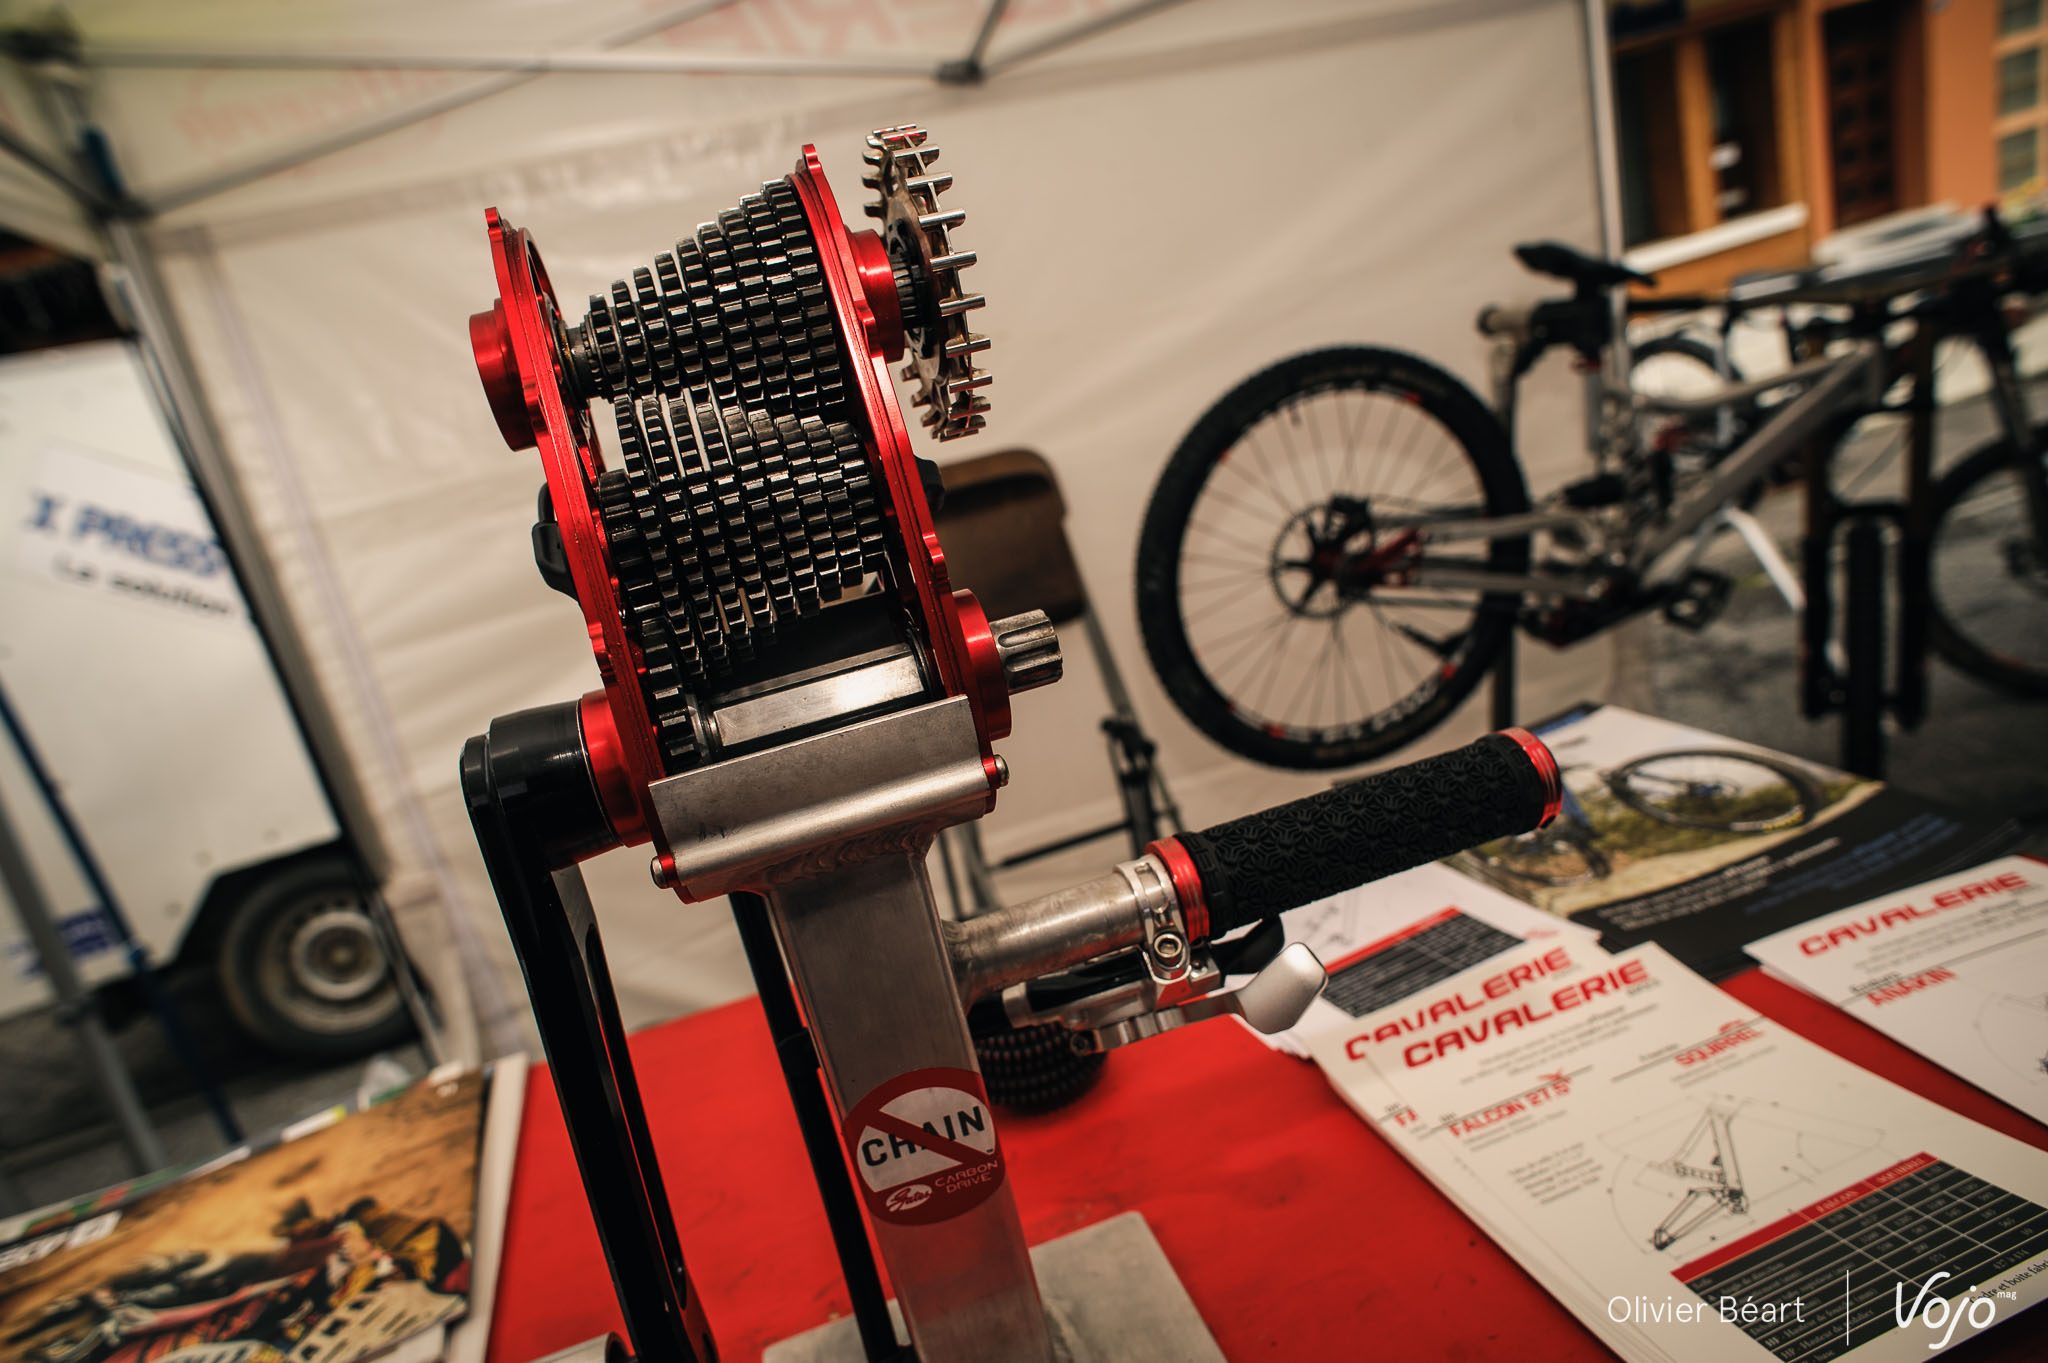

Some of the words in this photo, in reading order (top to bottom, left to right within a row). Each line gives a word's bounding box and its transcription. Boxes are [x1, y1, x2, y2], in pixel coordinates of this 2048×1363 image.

[1799, 872, 2029, 957] CAVALERIE
[1345, 947, 1571, 1061] CAVALERIE
[1404, 959, 1649, 1068] CAVALERIE
[861, 1105, 985, 1167] CHAIN
[1449, 1099, 1526, 1137] FALCON
[935, 1160, 998, 1188] CARBON
[946, 1172, 992, 1193] DRIVE
